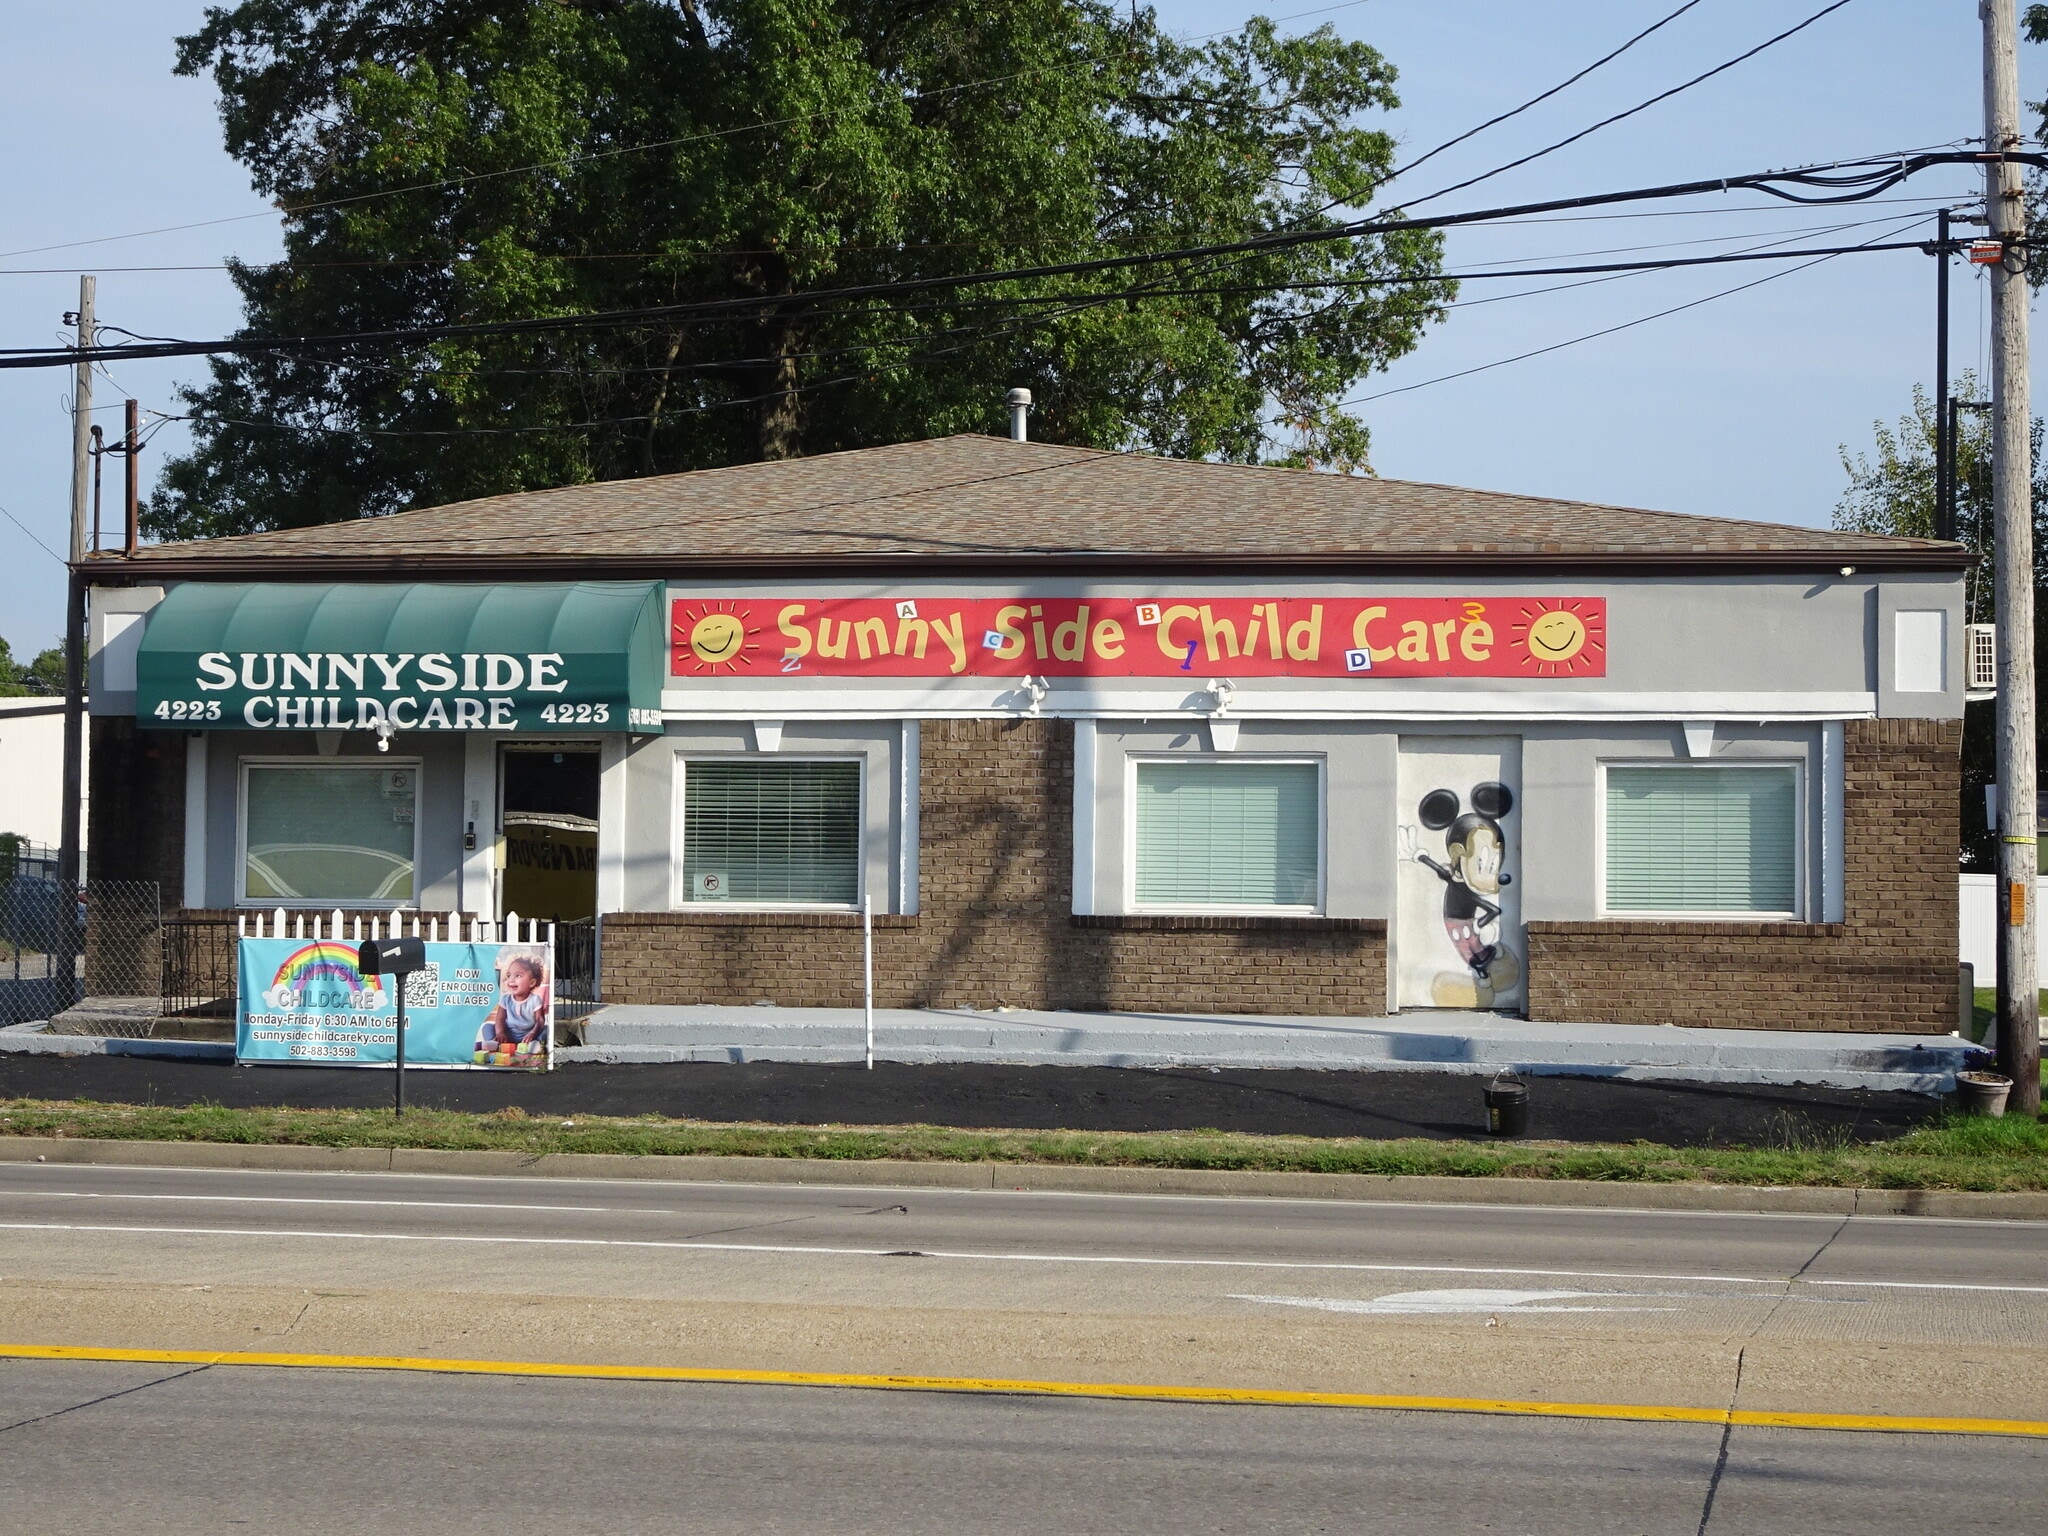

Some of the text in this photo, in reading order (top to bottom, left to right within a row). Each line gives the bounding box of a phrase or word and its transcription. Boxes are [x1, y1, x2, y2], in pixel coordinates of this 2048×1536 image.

[901, 603, 914, 617] A
[1142, 607, 1155, 621] B
[1460, 602, 1485, 623] 3
[777, 602, 1494, 673] Sunny Side Child Care
[1351, 652, 1367, 667] D
[196, 652, 568, 692] SUNNYSIDE
[153, 700, 222, 721] 4223
[243, 695, 519, 731] CHILDCARE
[540, 702, 610, 724] 4223
[456, 970, 480, 978] NOW
[441, 982, 494, 992] ENROLLING
[278, 989, 374, 1009] CHILDCARE
[444, 996, 489, 1005] ALL AGES
[244, 1012, 321, 1028] Monday-Friday
[324, 1015, 346, 1026] 6:30
[350, 1016, 368, 1027] AM
[371, 1016, 382, 1027] to
[253, 1031, 395, 1043] sunnysidechildcareky.com
[290, 1045, 356, 1057] 502-883-3598
